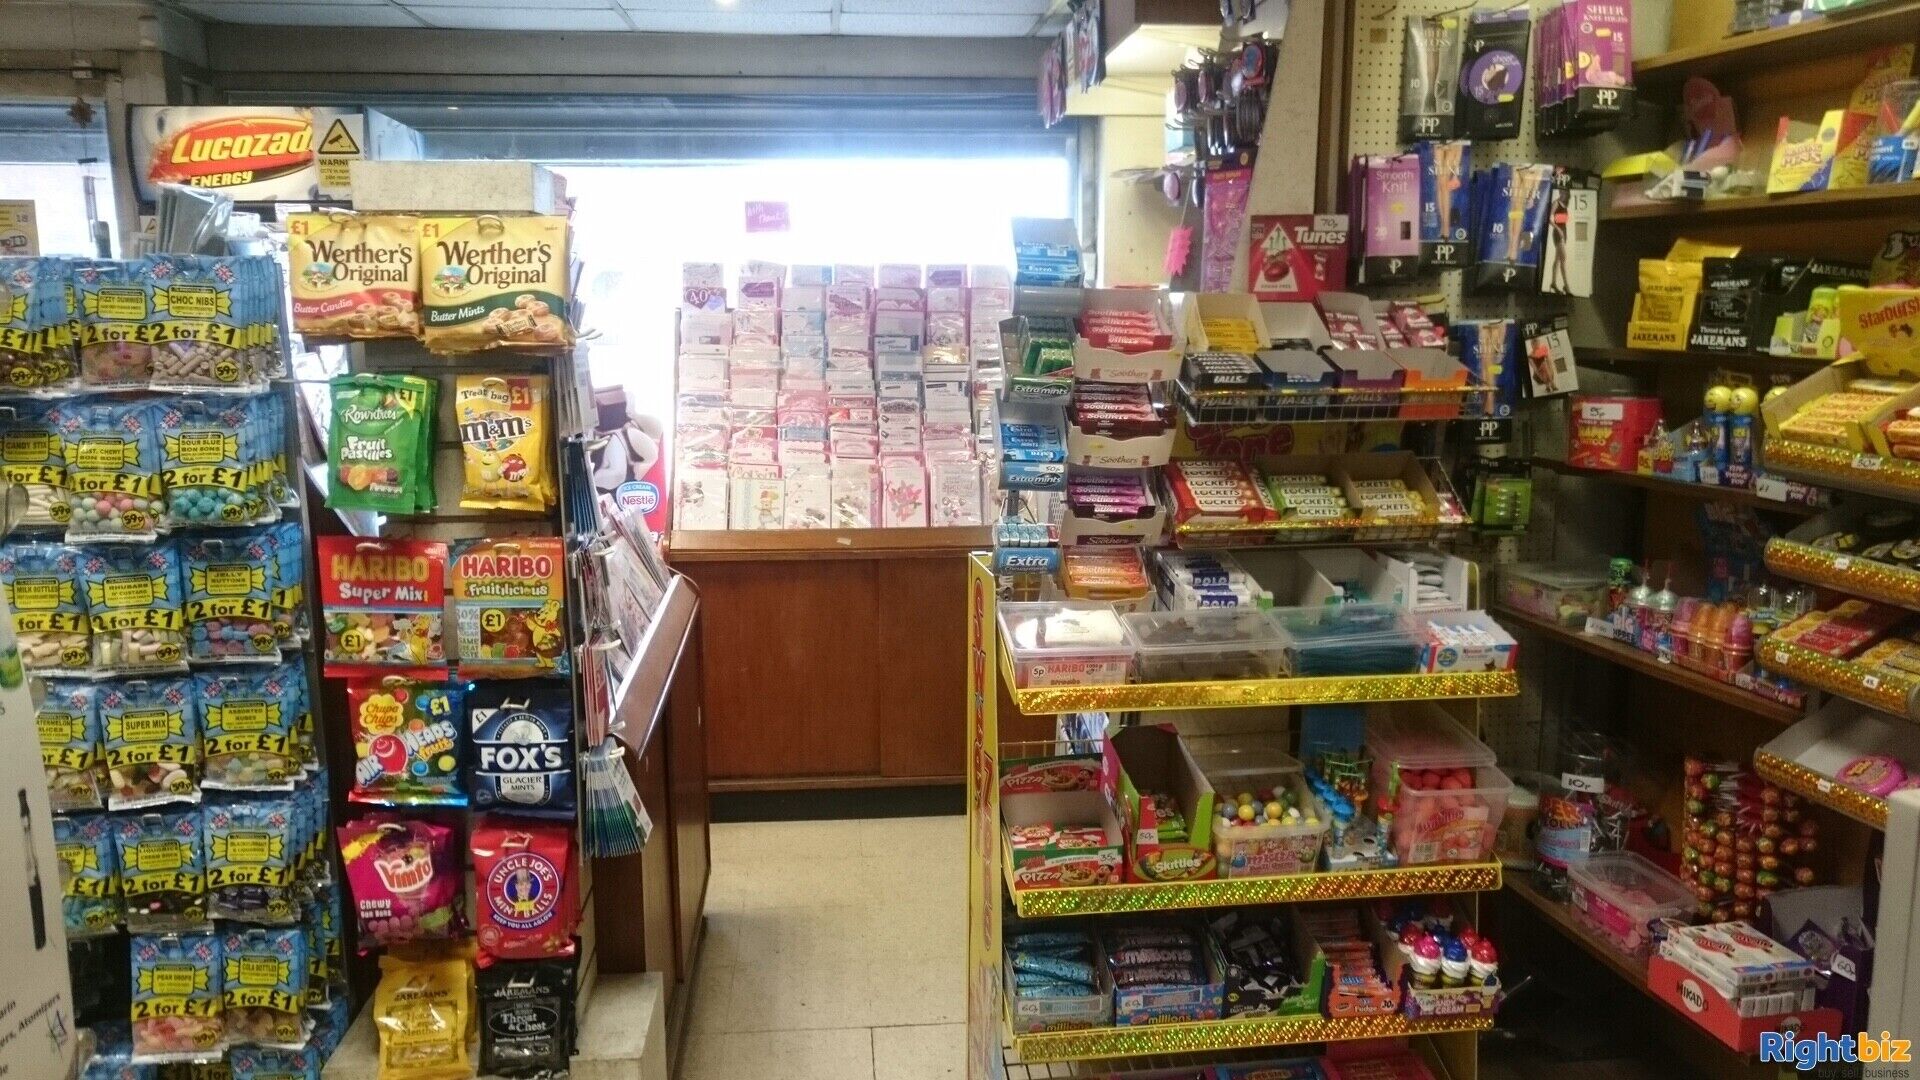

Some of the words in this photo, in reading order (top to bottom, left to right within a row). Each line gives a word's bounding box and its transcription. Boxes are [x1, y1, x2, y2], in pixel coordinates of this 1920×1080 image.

[1587, 5, 1623, 15] SHEER
[1613, 32, 1623, 42] 15
[170, 126, 313, 165] Lucozad
[319, 158, 349, 166] WARNI
[190, 171, 252, 187] ENERGY
[1377, 170, 1413, 180] Smooth
[1382, 181, 1408, 193] Knit
[1425, 203, 1435, 213] 15
[1573, 195, 1588, 210] 15
[290, 220, 309, 236] £1
[1321, 218, 1338, 229] 70p
[1492, 223, 1503, 233] 10
[422, 224, 439, 238] £1
[1294, 227, 1346, 244] Tunes
[305, 240, 413, 264] Werther's
[437, 240, 551, 265] Werther's
[332, 262, 408, 286] Original
[466, 262, 546, 288] Original
[171, 295, 193, 305] CHOC
[196, 296, 215, 306] NIBS
[294, 301, 319, 313] Butter
[321, 299, 353, 312] Candies
[431, 309, 456, 322] Butter
[459, 305, 485, 319] Mints
[151, 324, 168, 340] 2
[173, 327, 200, 339] for
[205, 324, 236, 345] £1
[1700, 326, 1717, 334] Throat
[1632, 333, 1675, 342] JAKEMANS
[1690, 335, 1747, 347] JAKEMANS
[217, 365, 237, 377] 59p
[1109, 370, 1148, 378] Soothers
[461, 389, 487, 400] Treat
[491, 391, 509, 403] bag
[511, 388, 530, 405] £1
[1014, 385, 1039, 394] Extra
[1041, 384, 1069, 395] mints
[347, 437, 386, 451] Fruit
[341, 448, 393, 461] Pastilles
[1100, 456, 1138, 464] Soothers
[7, 470, 32, 483] for
[39, 467, 67, 485] £1
[163, 469, 177, 487] 2
[182, 471, 206, 484] for
[210, 468, 242, 488] £1
[1036, 475, 1061, 484] mints
[79, 477, 107, 490] for
[112, 475, 141, 493] £1
[51, 505, 70, 516] 59p
[223, 507, 243, 518] 59p
[124, 514, 144, 525] 59p
[462, 555, 552, 578] HARIBO
[1007, 556, 1048, 566] Extra
[331, 555, 430, 582] HARIBO
[1195, 577, 1228, 585] POLO
[339, 582, 390, 603] Super
[191, 603, 207, 619] 2
[210, 602, 236, 616] for
[241, 600, 271, 618] £1
[18, 617, 43, 631] for
[49, 613, 81, 631] £1
[487, 613, 501, 627] £1
[253, 636, 273, 648] 59p
[344, 634, 361, 647] £1
[63, 651, 84, 663] 59p
[1033, 668, 1044, 677] 5p
[1048, 664, 1084, 673] HARIBO
[366, 703, 398, 718] Chupa
[430, 697, 449, 716] £1
[125, 720, 150, 730] SUPER
[152, 719, 167, 730] MIX
[364, 714, 399, 730] Chups
[407, 721, 457, 754] HEADS
[205, 739, 222, 755] 2
[225, 737, 251, 751] for
[257, 735, 287, 753] £1
[108, 750, 124, 767] 2
[127, 749, 153, 763] for
[159, 745, 189, 761] £1
[480, 744, 562, 770] FOX'S
[355, 756, 384, 787] AIR
[503, 776, 542, 785] GLACIER
[1007, 776, 1042, 787] PIZZA
[494, 858, 528, 884] UNCLE
[1155, 859, 1200, 873] Skittles
[208, 869, 224, 884] 2
[229, 868, 254, 883] for
[257, 867, 285, 884] £1
[384, 864, 432, 889] Vimto
[1021, 872, 1062, 883] PIZZA
[124, 878, 137, 896] 2
[142, 878, 168, 892] for
[173, 874, 200, 891] £1
[494, 895, 518, 918] MINT
[524, 892, 553, 918] BALLS
[494, 986, 549, 998] JAKEMANS
[1676, 982, 1709, 1012] MIKADO
[135, 1003, 149, 1018] 2
[154, 1002, 180, 1016] for
[184, 1000, 211, 1016] £1
[501, 1012, 536, 1025] Throat
[1148, 1014, 1191, 1024] millions
